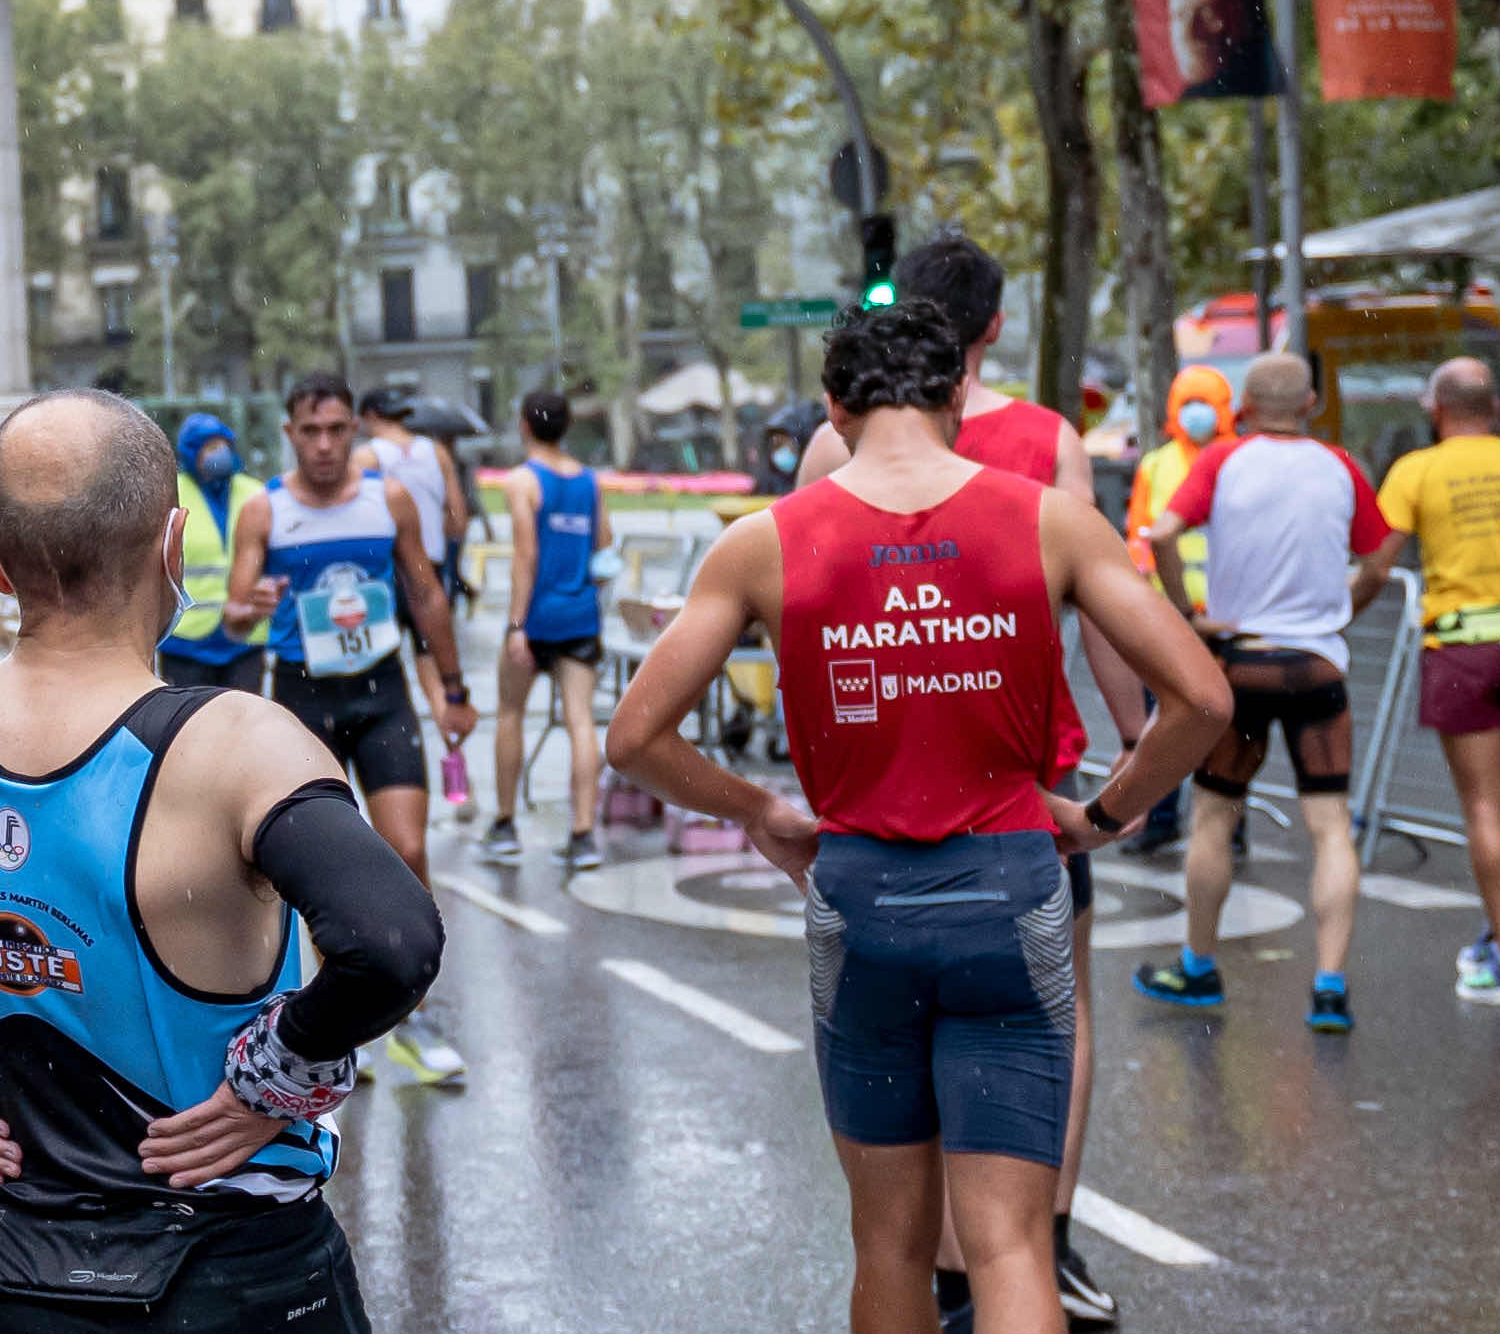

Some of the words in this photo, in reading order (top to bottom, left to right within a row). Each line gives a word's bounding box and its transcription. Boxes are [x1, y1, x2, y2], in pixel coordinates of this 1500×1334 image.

[884, 584, 951, 612] A.D.
[337, 627, 374, 654] 151
[821, 612, 1017, 650] MARATHON
[906, 670, 1003, 695] MADRID
[287, 1297, 327, 1321] DRI-FIT
